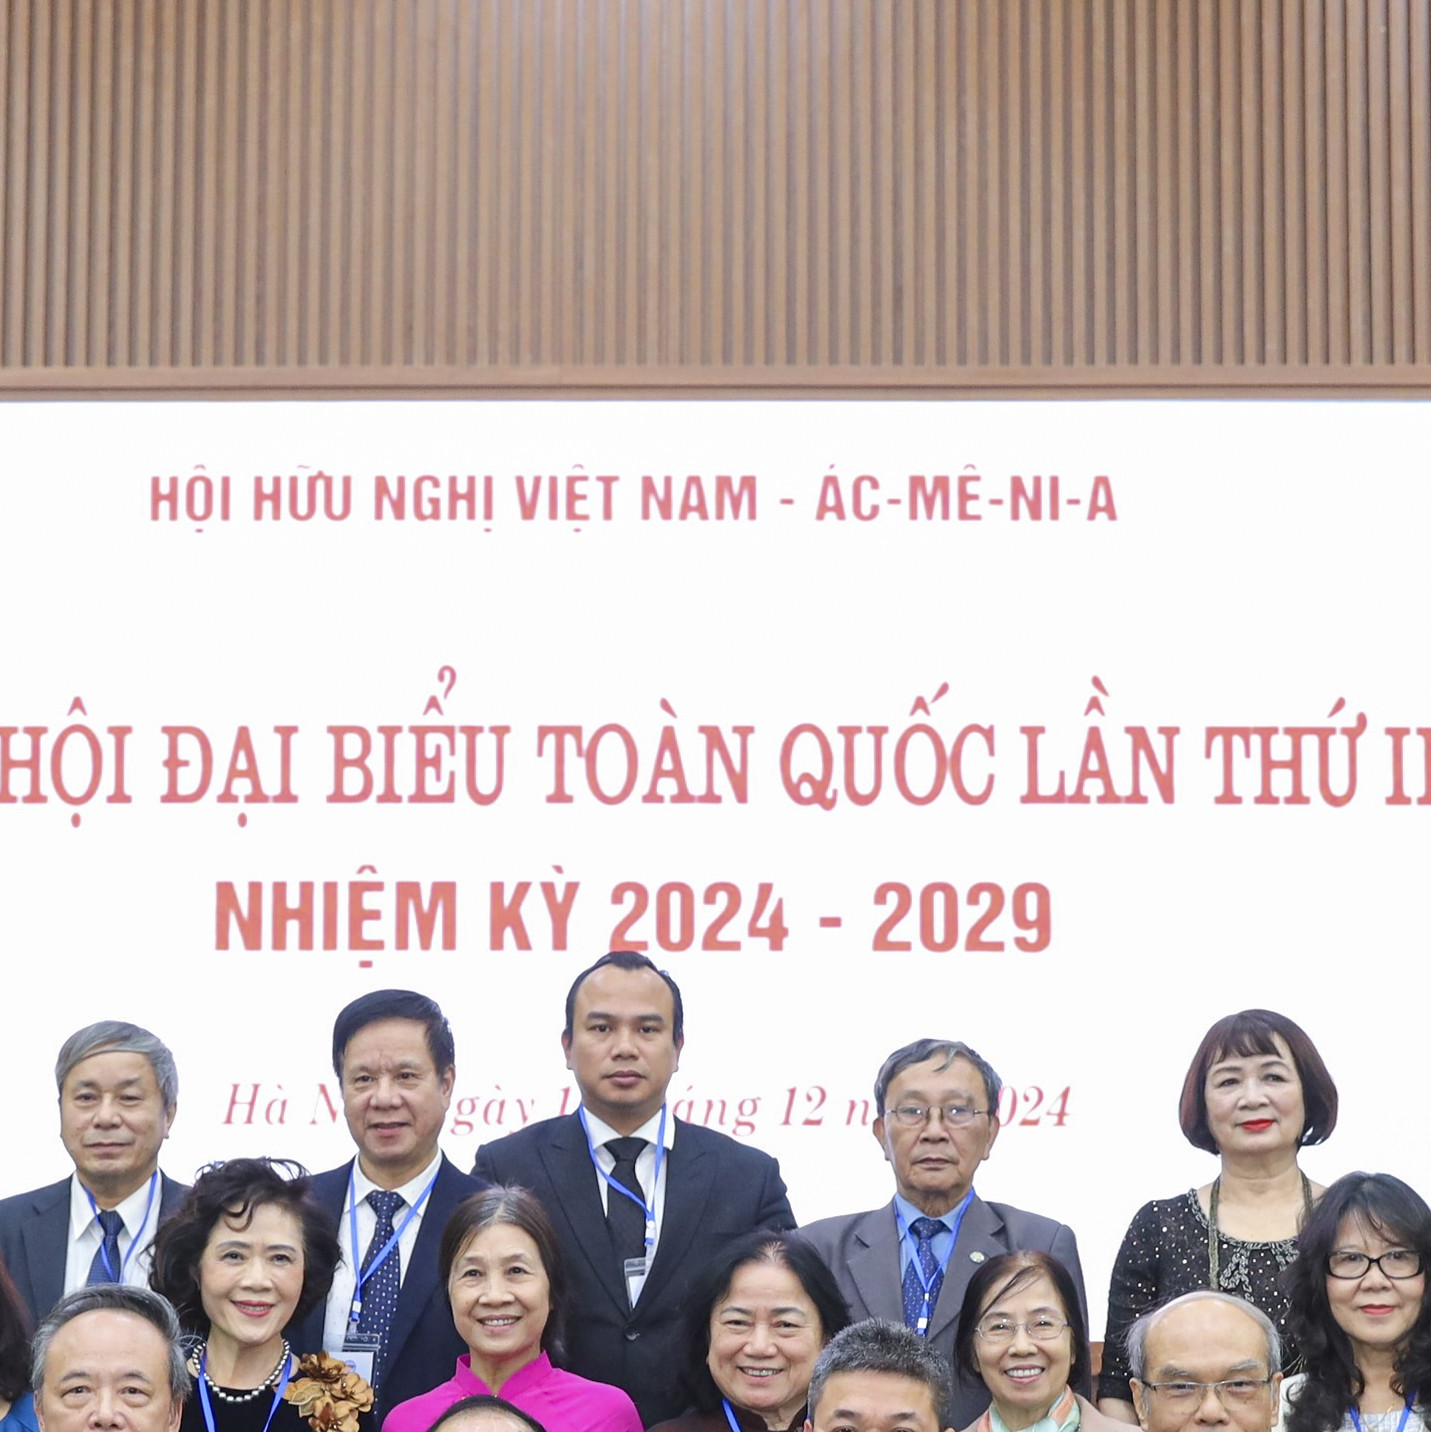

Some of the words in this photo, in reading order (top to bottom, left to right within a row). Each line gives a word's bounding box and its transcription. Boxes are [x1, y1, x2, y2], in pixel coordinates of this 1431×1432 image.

[151, 464, 230, 534] HỘI
[253, 465, 352, 522] HỮU
[374, 474, 494, 534] NGHỊ
[515, 464, 621, 534] VIỆT
[640, 474, 758, 522] NAM
[815, 463, 1119, 522] ÁC-MÊ-NI-A
[159, 724, 300, 829] ĐẠI
[325, 664, 512, 807] BIỂU
[536, 697, 756, 807] TOÀN
[779, 681, 996, 812] QUỐC
[1018, 674, 1182, 806] LẦN
[1204, 696, 1369, 809] THỨ
[215, 863, 458, 970] NHIỆM
[489, 864, 582, 952] KỲ
[609, 880, 790, 953] 2024
[871, 880, 1052, 954] 2029
[222, 1083, 288, 1125] Hà
[450, 1084, 535, 1136] gày
[672, 1085, 762, 1137] áng
[779, 1085, 827, 1127] 12
[995, 1085, 1071, 1128] 024
